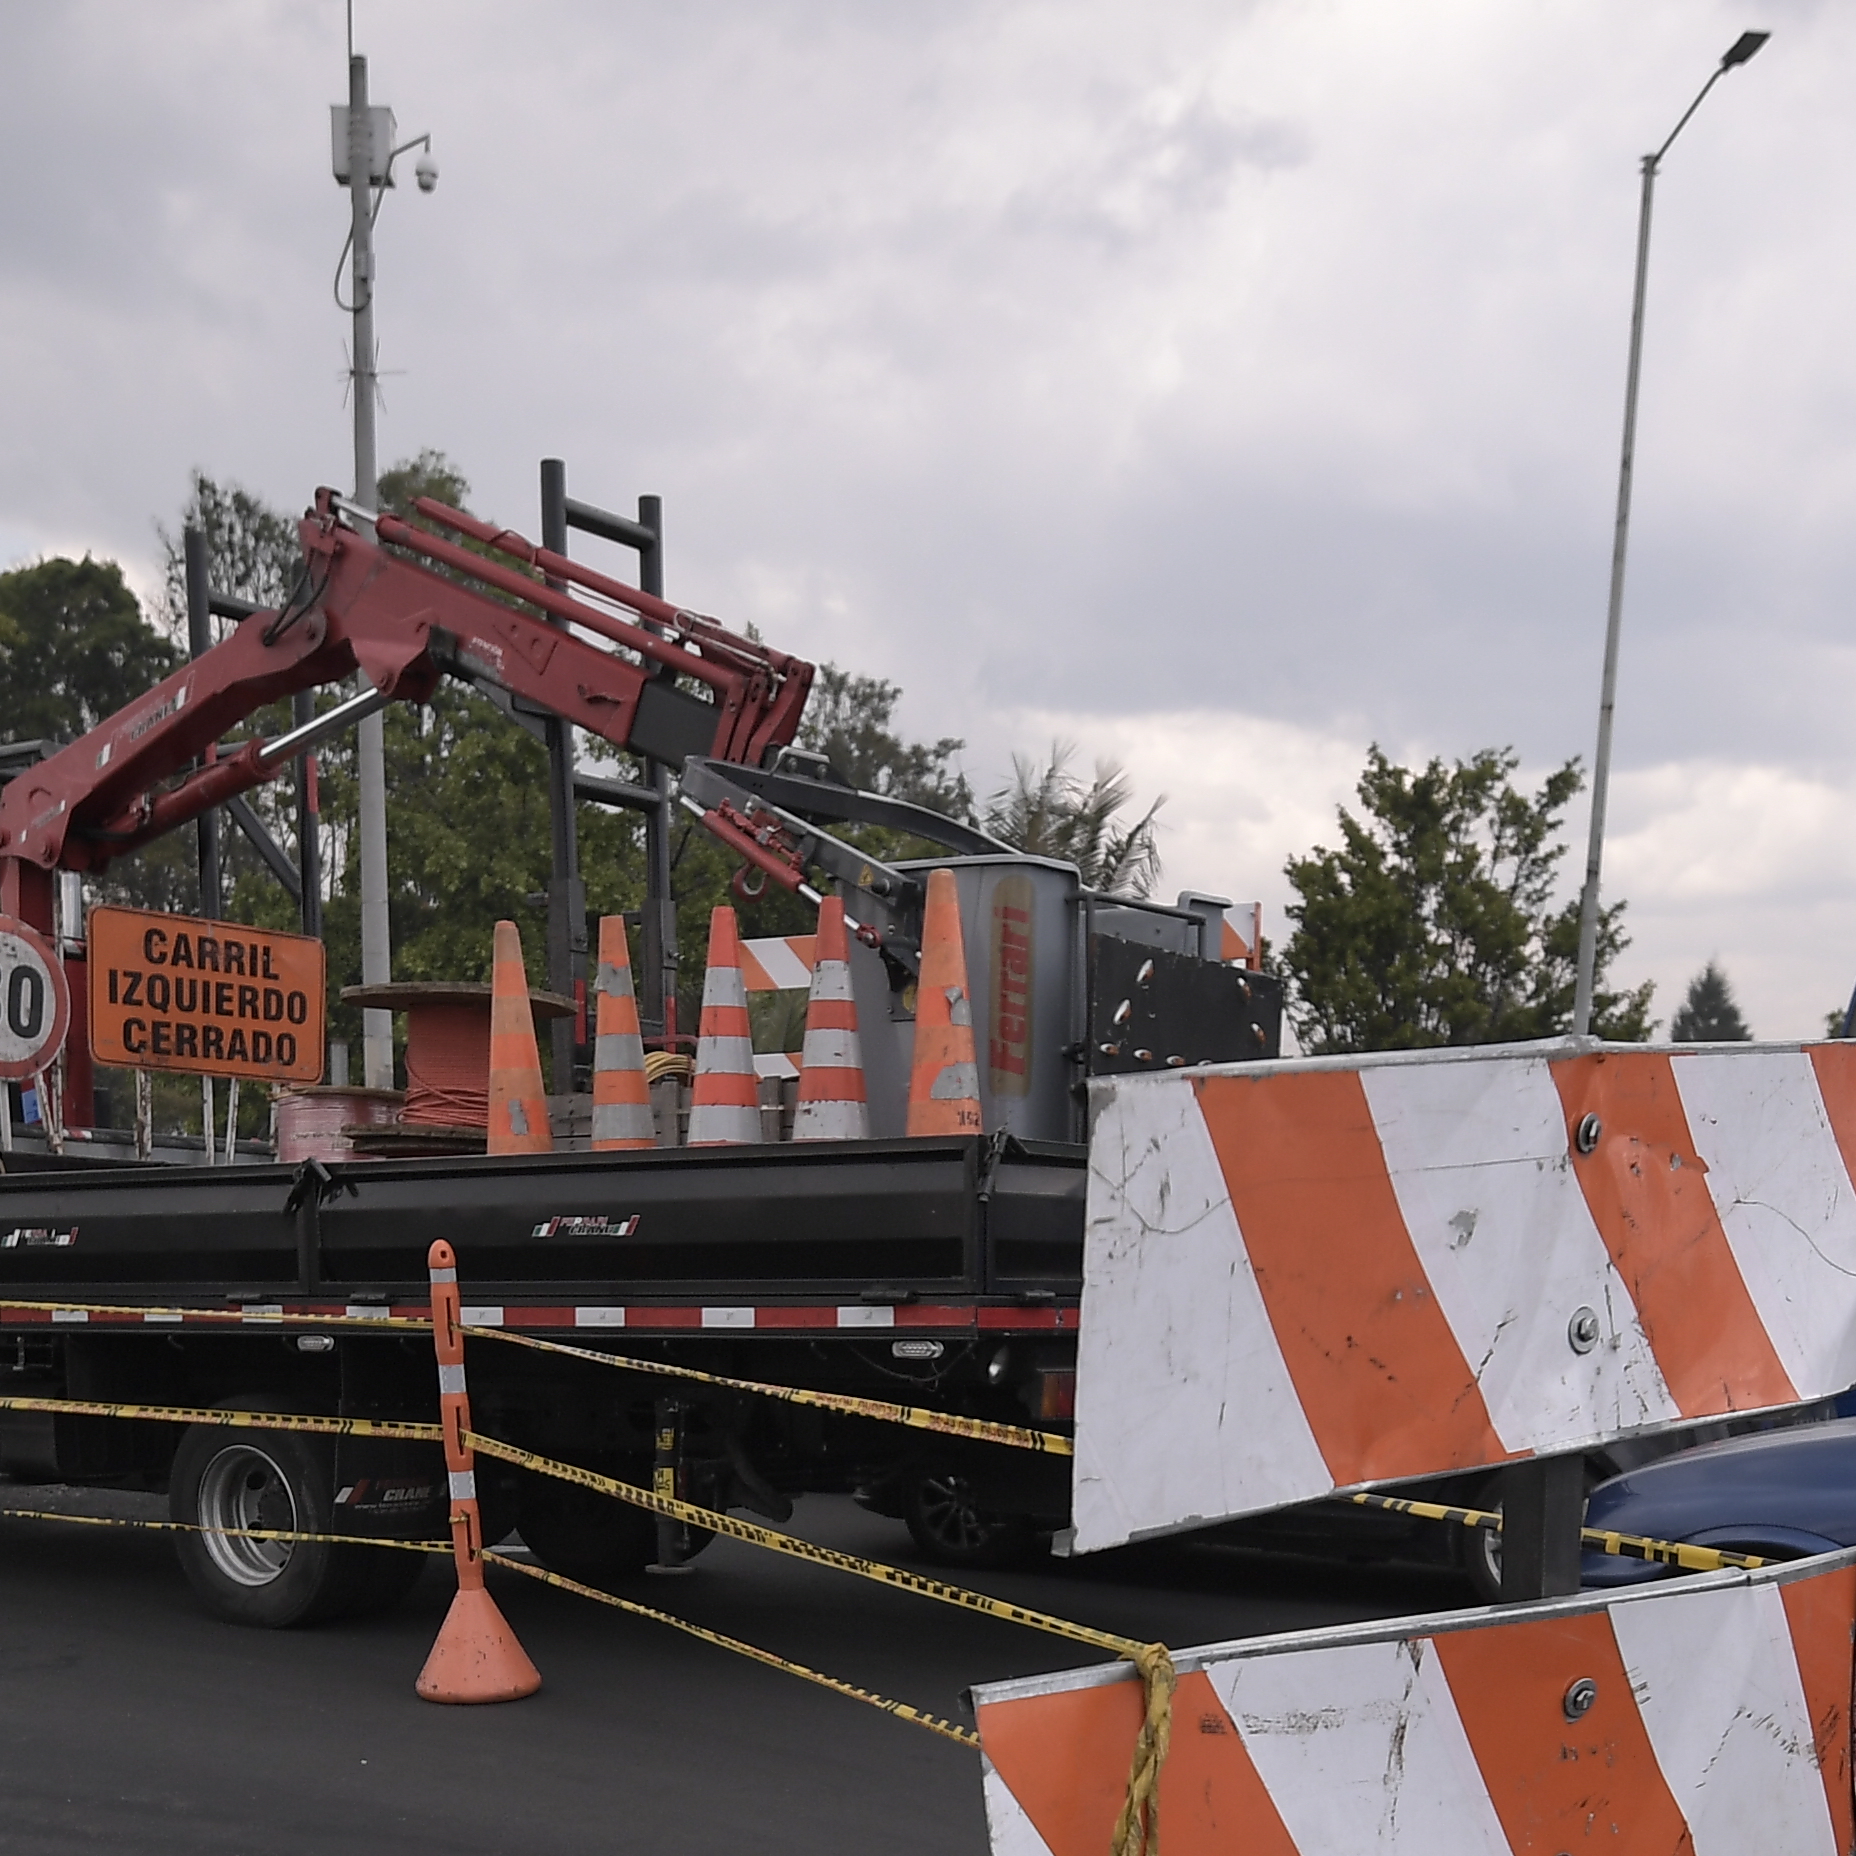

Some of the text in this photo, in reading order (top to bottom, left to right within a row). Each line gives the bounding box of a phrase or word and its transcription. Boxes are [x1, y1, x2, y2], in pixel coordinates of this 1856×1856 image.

[144, 928, 280, 981] CARRIL
[108, 968, 308, 1025] IZQUIERDO
[989, 906, 1031, 1076] Ferrari
[122, 1017, 297, 1067] CERRADO
